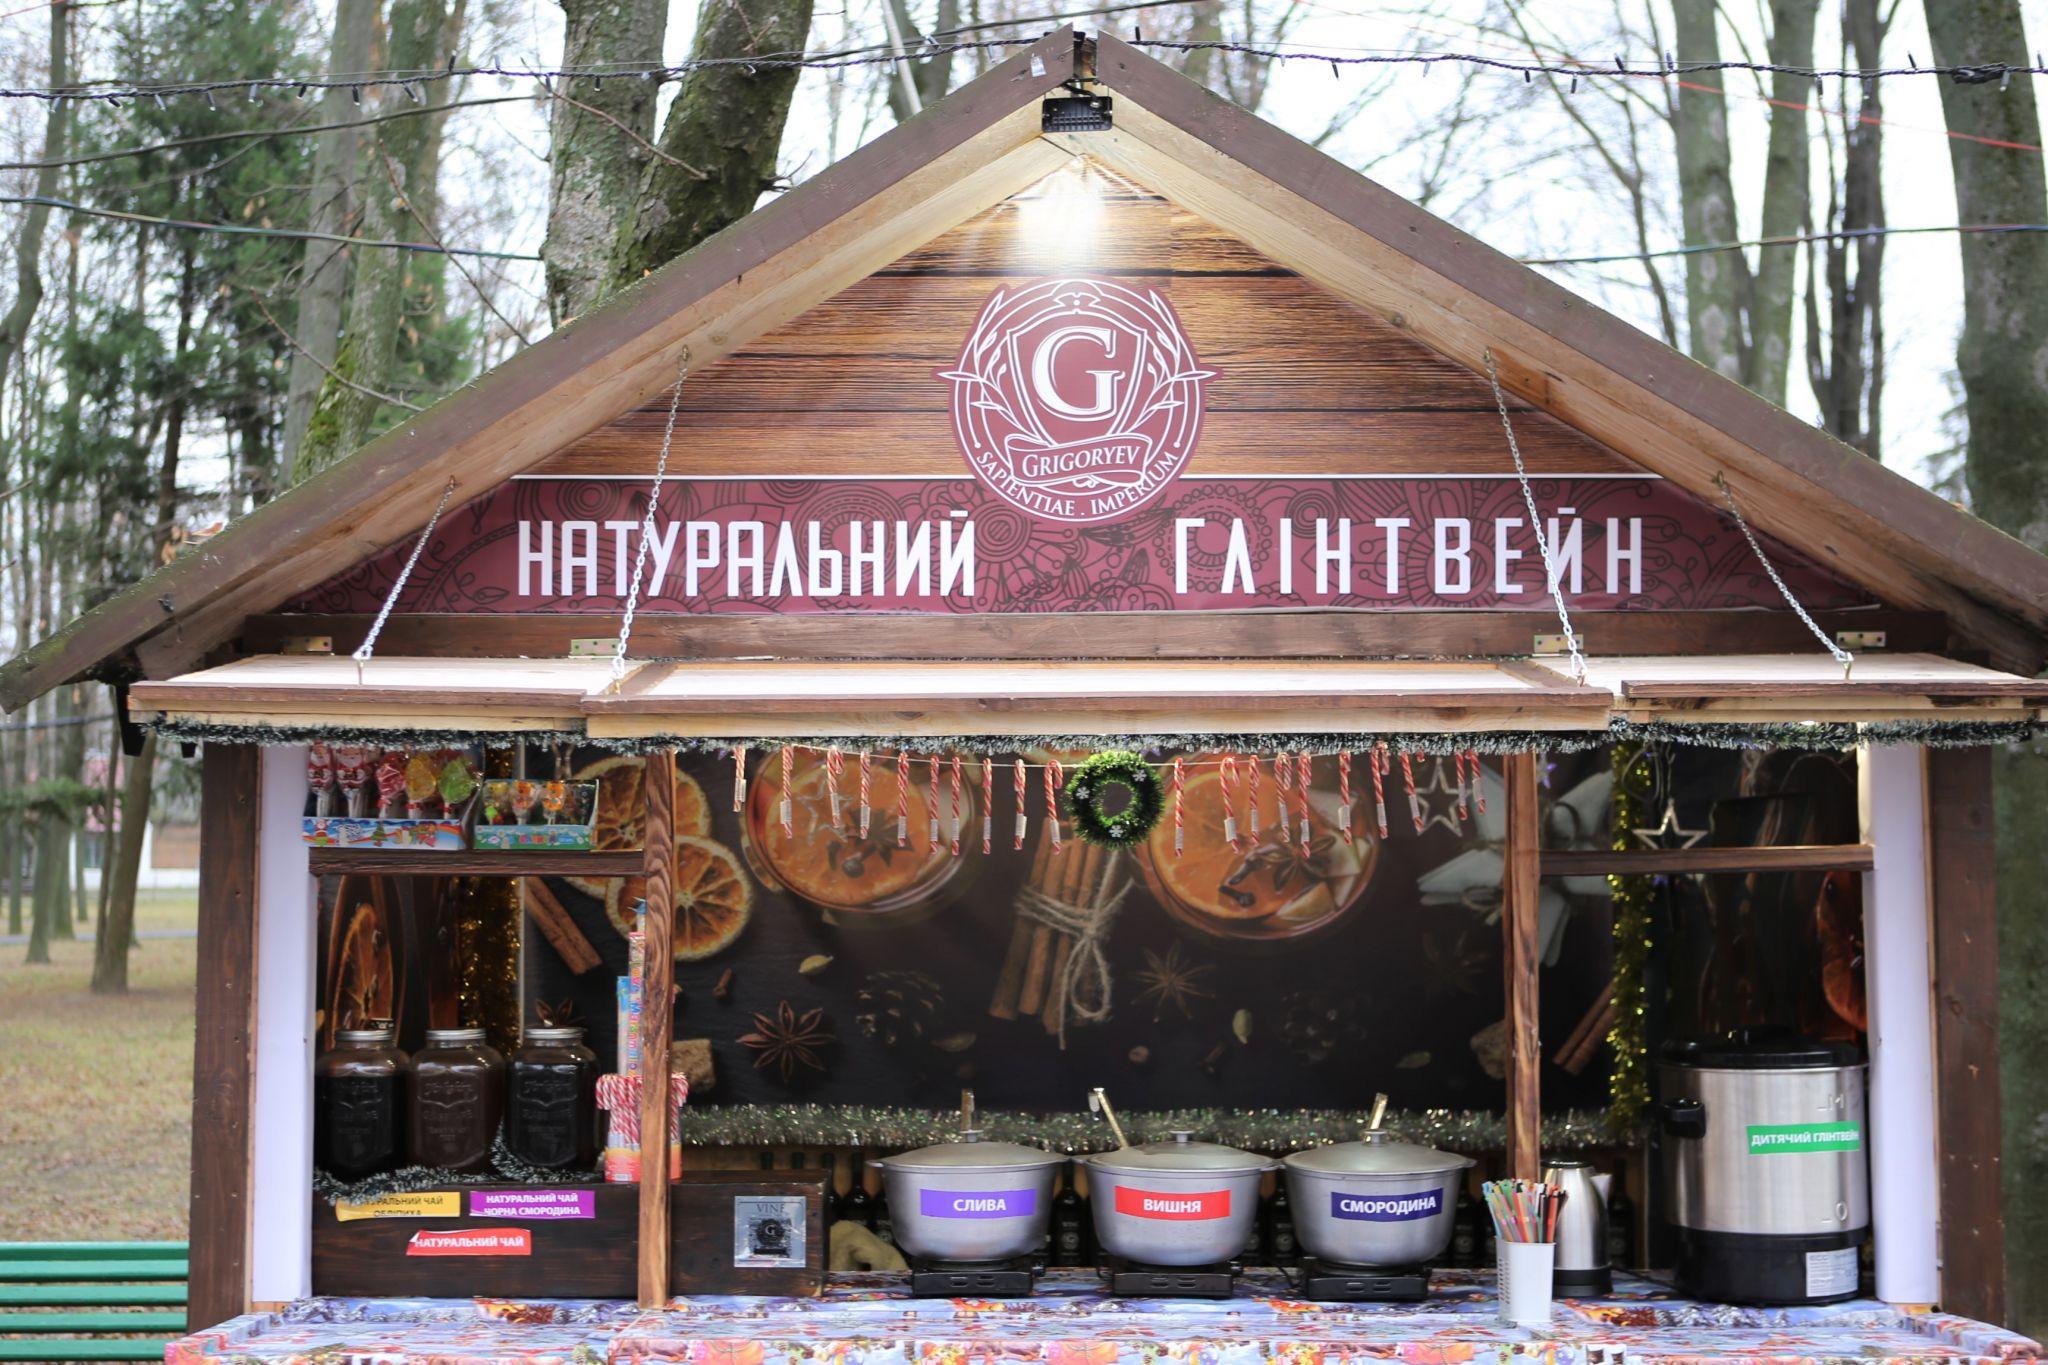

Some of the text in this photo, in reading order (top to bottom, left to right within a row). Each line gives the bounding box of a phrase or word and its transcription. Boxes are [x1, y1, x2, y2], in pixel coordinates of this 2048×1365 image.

[1032, 326, 1126, 422] G
[1021, 445, 1142, 478] GRIGORYEV
[1091, 452, 1180, 515] IMPERIUM
[518, 507, 1643, 597] НАТУРАЛЬНИЙ ГЛІНТВЕЙН
[1751, 1132, 1811, 1146] ДИТЯЧИЙ
[424, 1196, 444, 1205] ЧАЙ
[486, 1193, 578, 1204] НАТУРАЛЬНИЙ ЧАЙ
[953, 1199, 1007, 1212] СЛИВА
[1143, 1198, 1202, 1213] ВИШНЯ
[484, 1206, 581, 1216] ЧОРНА СМОРОДИНА
[1340, 1196, 1437, 1220] СМОРОДИНА
[415, 1236, 524, 1248] НАТУРАЛЬНИЙ ЧАЙ
